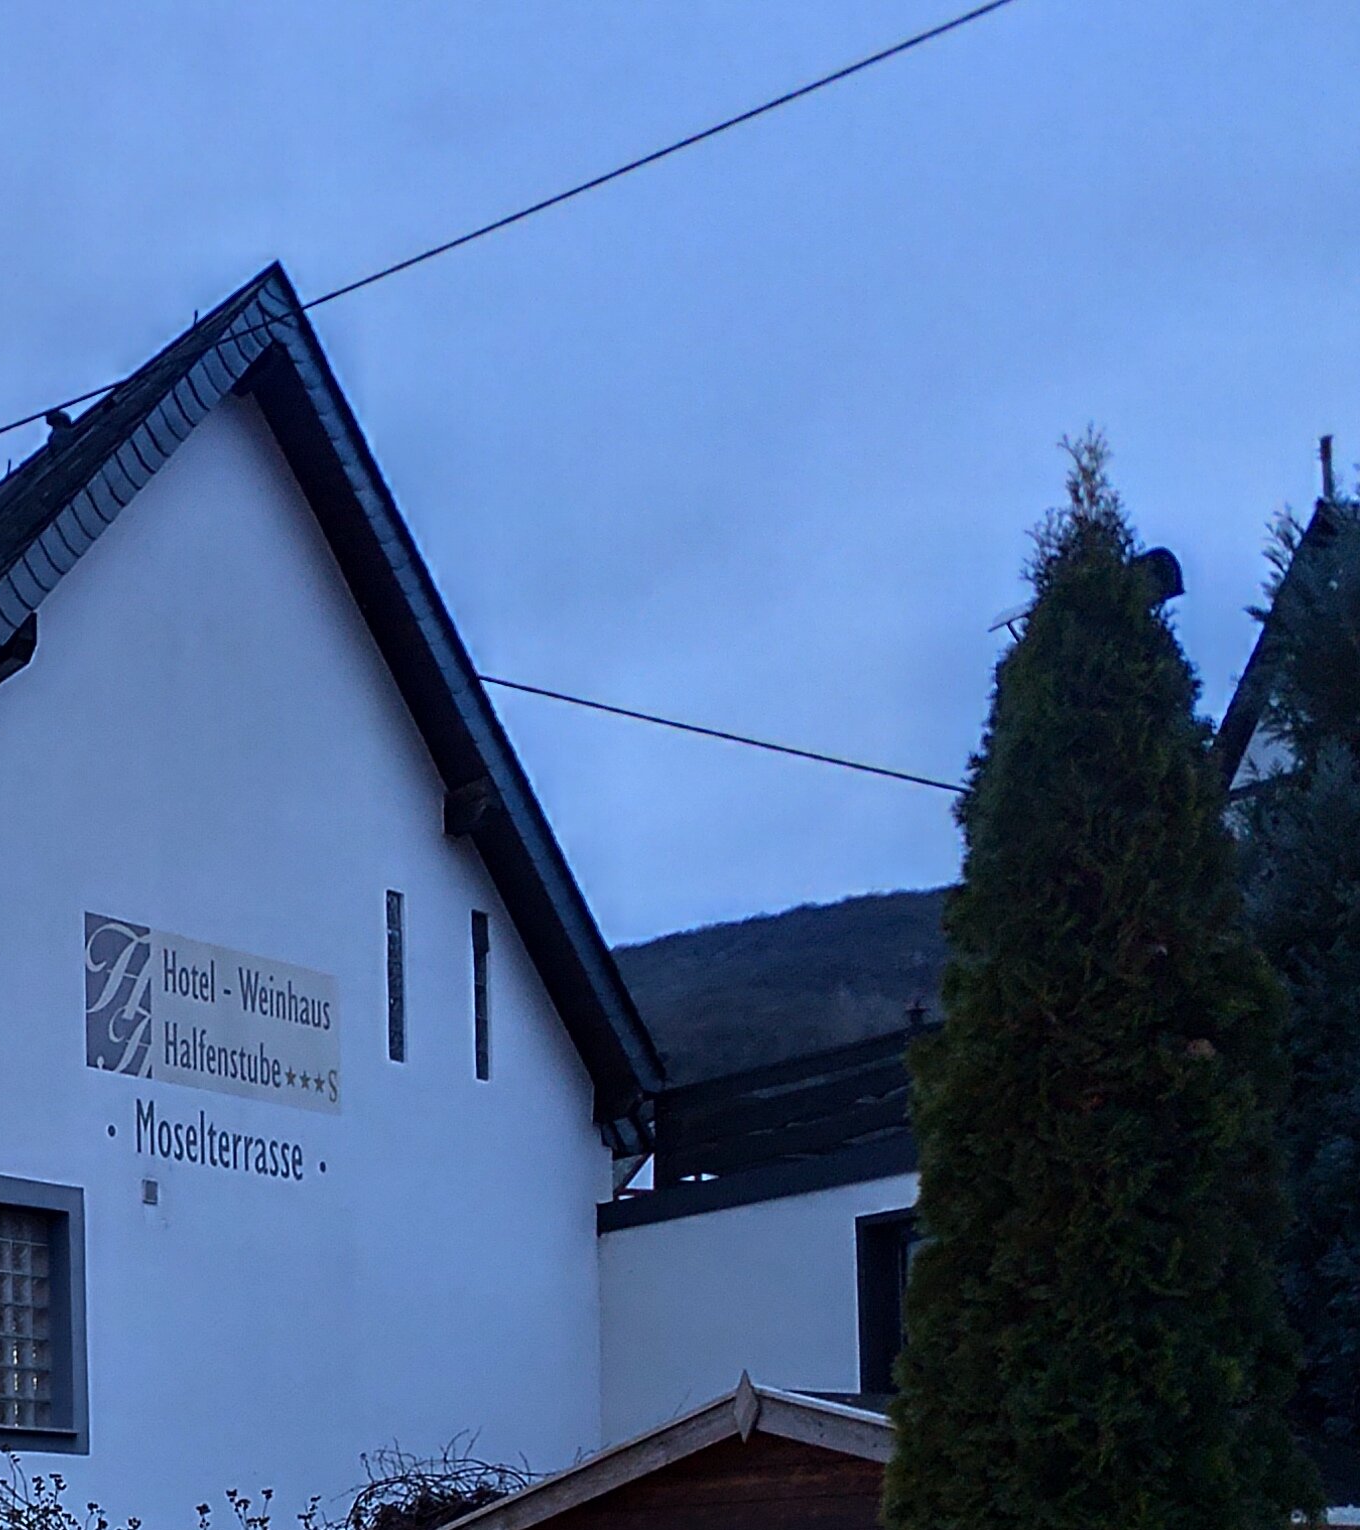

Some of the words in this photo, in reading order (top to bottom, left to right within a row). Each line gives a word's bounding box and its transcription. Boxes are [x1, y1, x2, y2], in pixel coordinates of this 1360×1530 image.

[163, 948, 216, 1003] Hotel
[238, 966, 331, 1031] Weinhaus
[164, 1021, 282, 1088] Halfenstube
[136, 1098, 303, 1181] Moselterrasse
